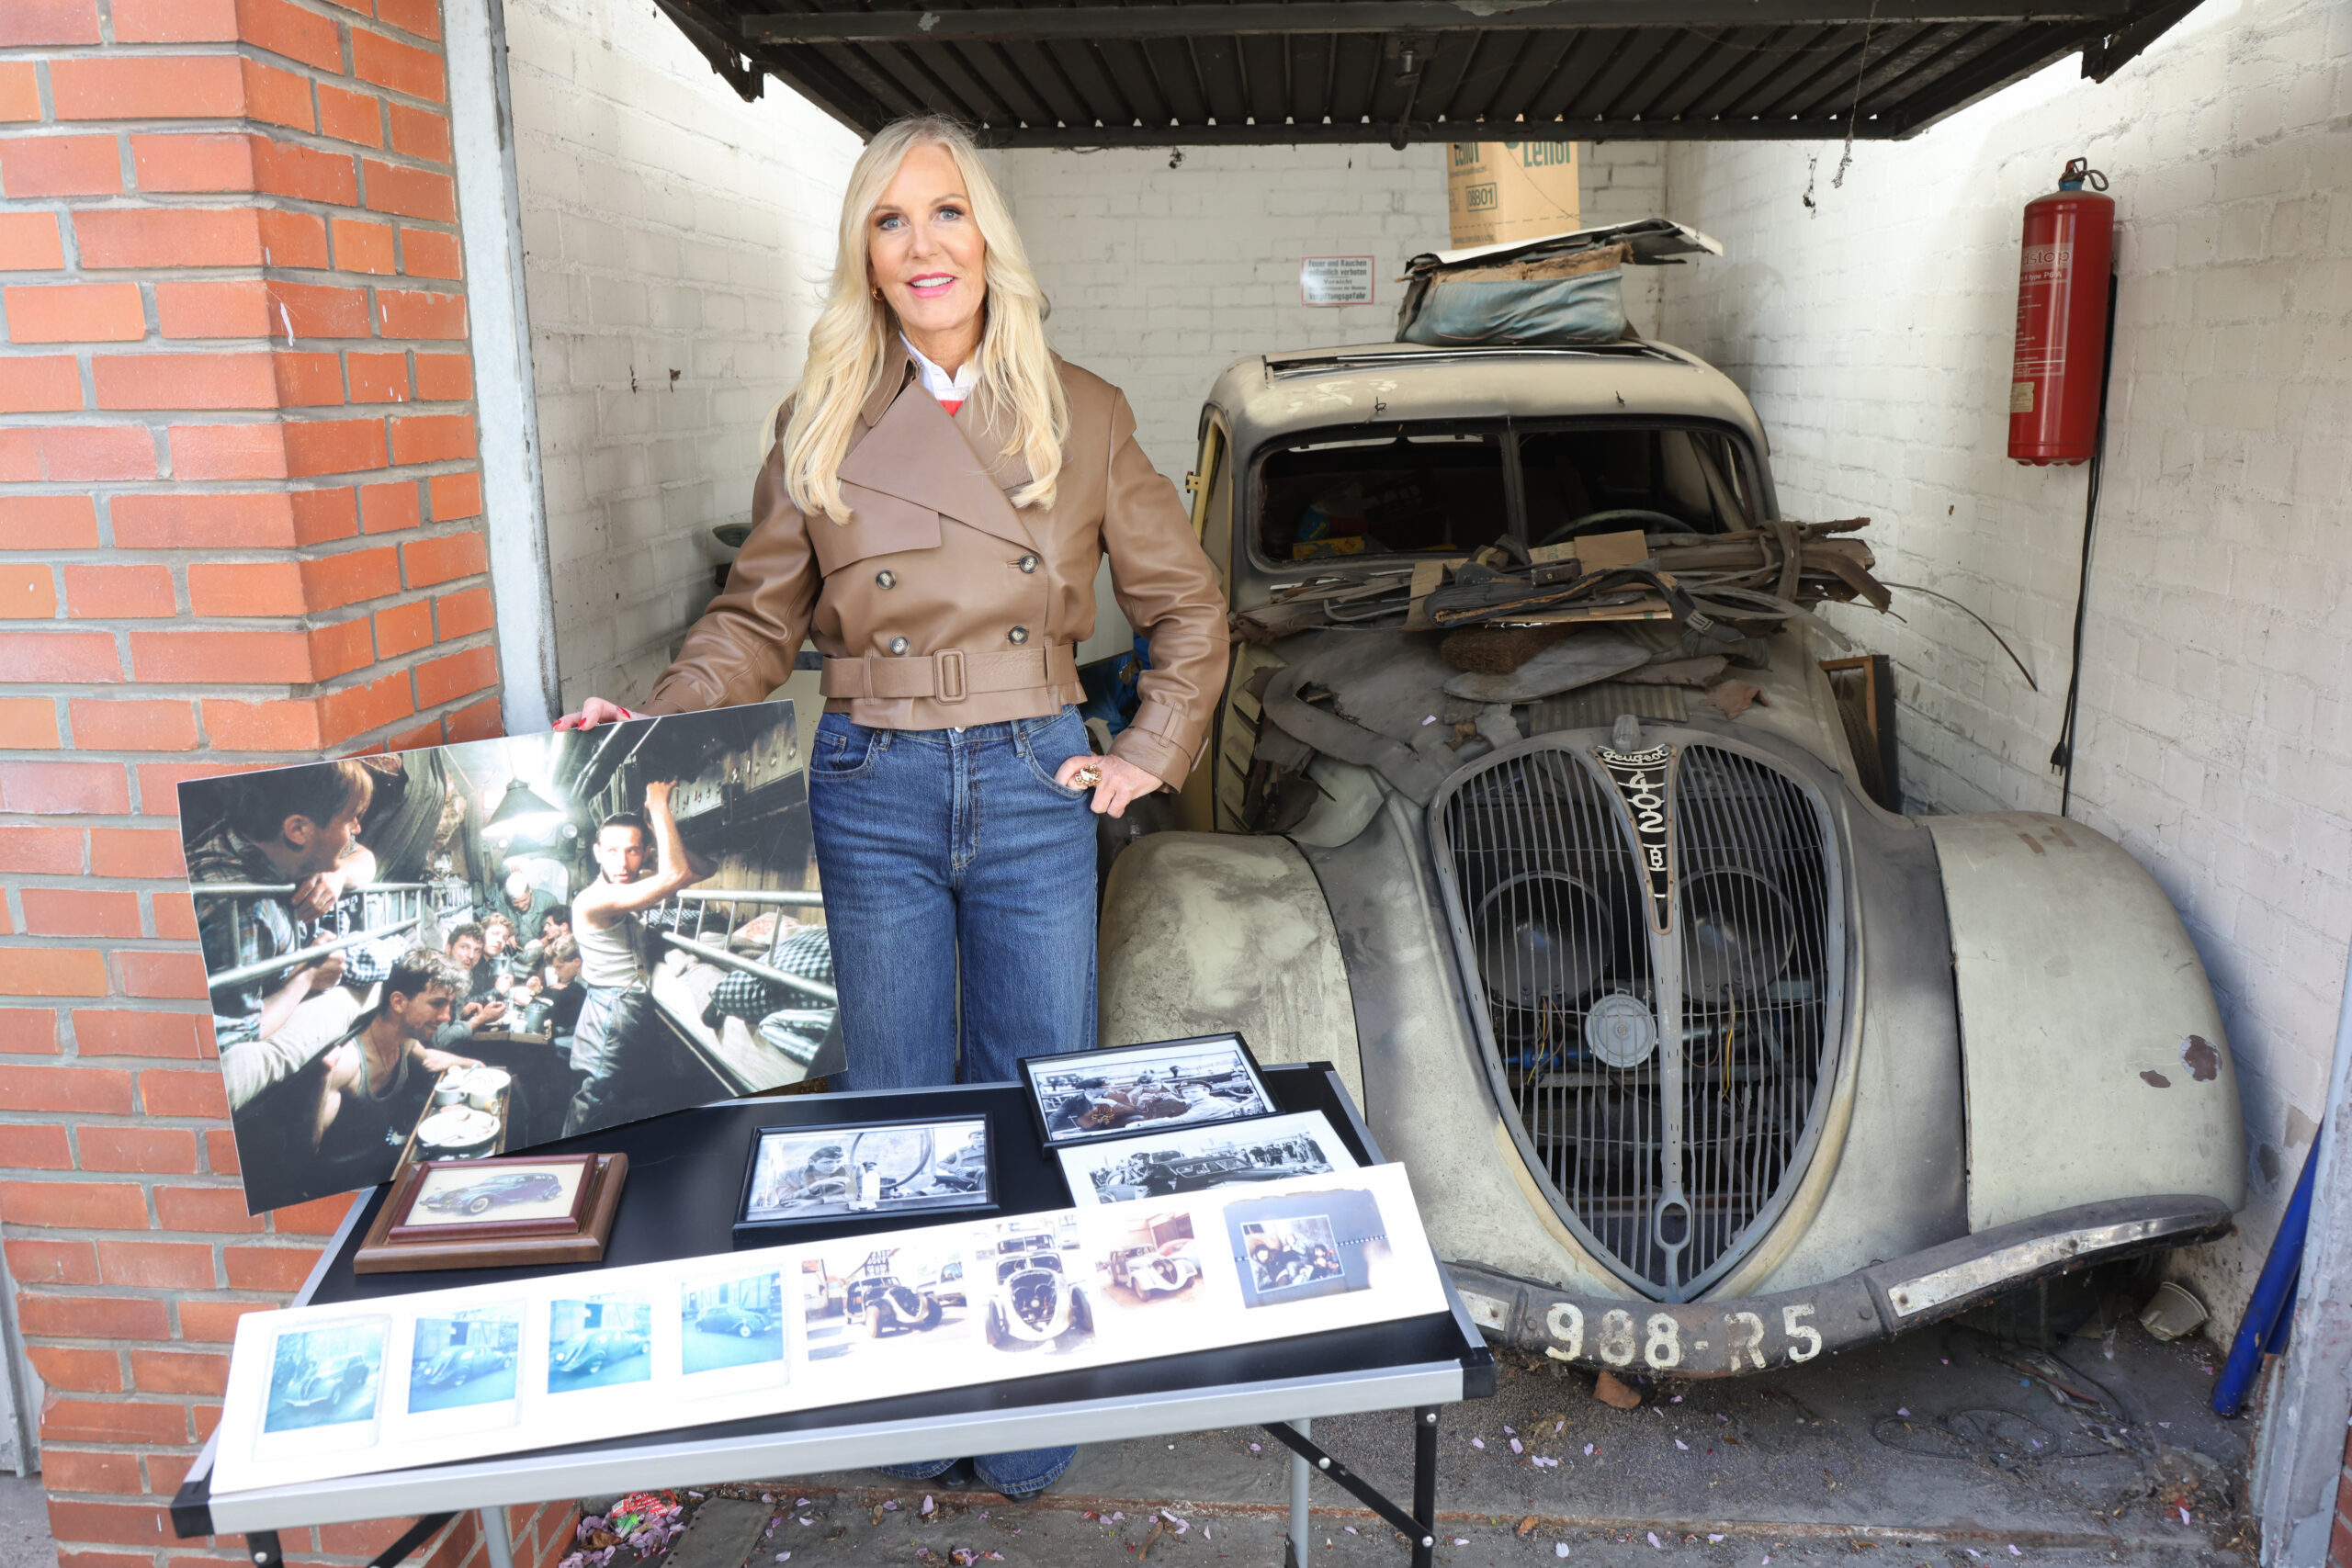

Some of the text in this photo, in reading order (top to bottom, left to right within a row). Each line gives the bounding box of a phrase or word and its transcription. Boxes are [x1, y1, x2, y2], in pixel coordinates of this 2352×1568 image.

[1328, 259, 1339, 267] und
[1629, 771, 1666, 833] 402
[1650, 847, 1664, 868] B
